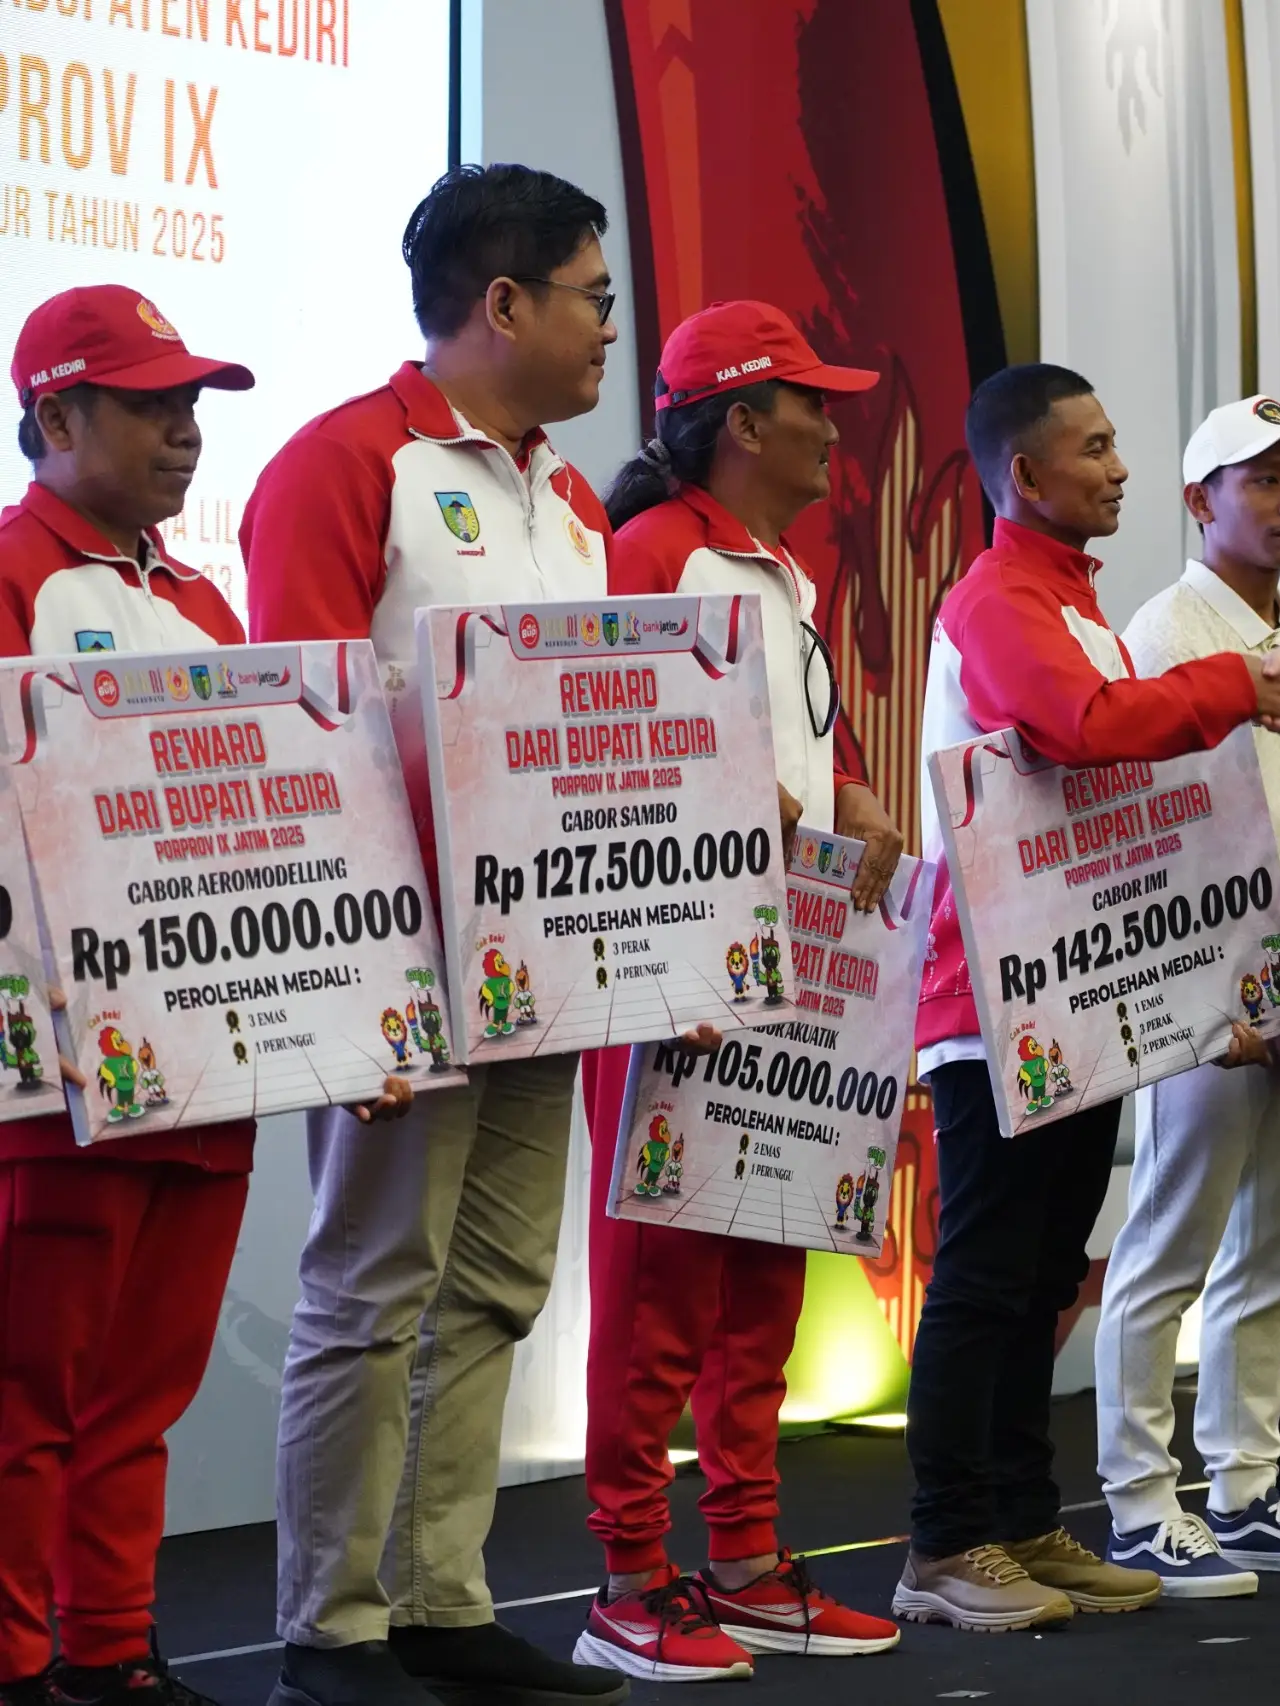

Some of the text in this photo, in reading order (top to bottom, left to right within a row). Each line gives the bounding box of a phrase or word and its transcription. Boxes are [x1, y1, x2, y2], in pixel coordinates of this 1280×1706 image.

[225, 0, 349, 67] KEDIRI
[0, 52, 219, 190] ROV IX
[45, 189, 139, 252] TAHUN
[151, 205, 225, 264] 2025
[29, 357, 86, 387] KAB. KEDIRI
[715, 356, 771, 383] KAB. KEDIRI
[642, 620, 680, 635] bankjatim
[559, 668, 657, 714] REWARD
[149, 722, 266, 773] REWARD
[505, 718, 717, 770] DARI BUPATI KEDIRI
[94, 772, 341, 834] DARI BUPATI KEDIRI
[551, 766, 682, 798] PORPROV IX JATIM 2025
[1062, 761, 1153, 813] REWARD
[562, 801, 677, 833] CABOR SAMBO
[1018, 782, 1212, 873] DARI BUPATI KEDIRI
[154, 825, 306, 862] PORPROV IX JATIM 2025
[1064, 833, 1182, 889] PORPROV IX JATIM 2025
[127, 857, 347, 905] CABOR AEROMODELLING
[474, 854, 524, 915] Rp
[533, 827, 770, 900] 127.500.000
[1092, 869, 1168, 911] CABOR IMI
[544, 908, 642, 939] PEROLEHAN
[646, 900, 705, 926] MEDALI
[787, 888, 846, 939] EWARD
[1000, 866, 1273, 1004] Rp 142.500.000
[71, 885, 423, 990] Rp 150.000.000
[613, 938, 651, 956] 3 PERAK
[164, 975, 279, 1012] PEROLEHAN
[285, 965, 351, 995] MEDALI
[614, 961, 670, 981] 4 PERUNGGU
[792, 943, 879, 998] PATI KEDIRI
[1069, 969, 1160, 1014] PEROLEHAN
[1162, 947, 1216, 979] MEDALI
[248, 1009, 288, 1028] 3 EMAS
[795, 987, 845, 1016] JATIM 2025
[1140, 993, 1164, 1012] EMAS
[261, 1032, 317, 1054] PERUNGGU
[784, 1022, 840, 1050] AKUATIK
[1139, 1013, 1174, 1036] 3 PERAK
[1143, 1026, 1196, 1056] 2 PERUNGGU
[702, 1040, 898, 1120] 105.000.000
[705, 1101, 784, 1140] PEROLEHAN
[786, 1119, 834, 1146] MEDALI
[754, 1142, 782, 1159] 2 EMAS
[756, 1164, 794, 1182] PERUNGGU
